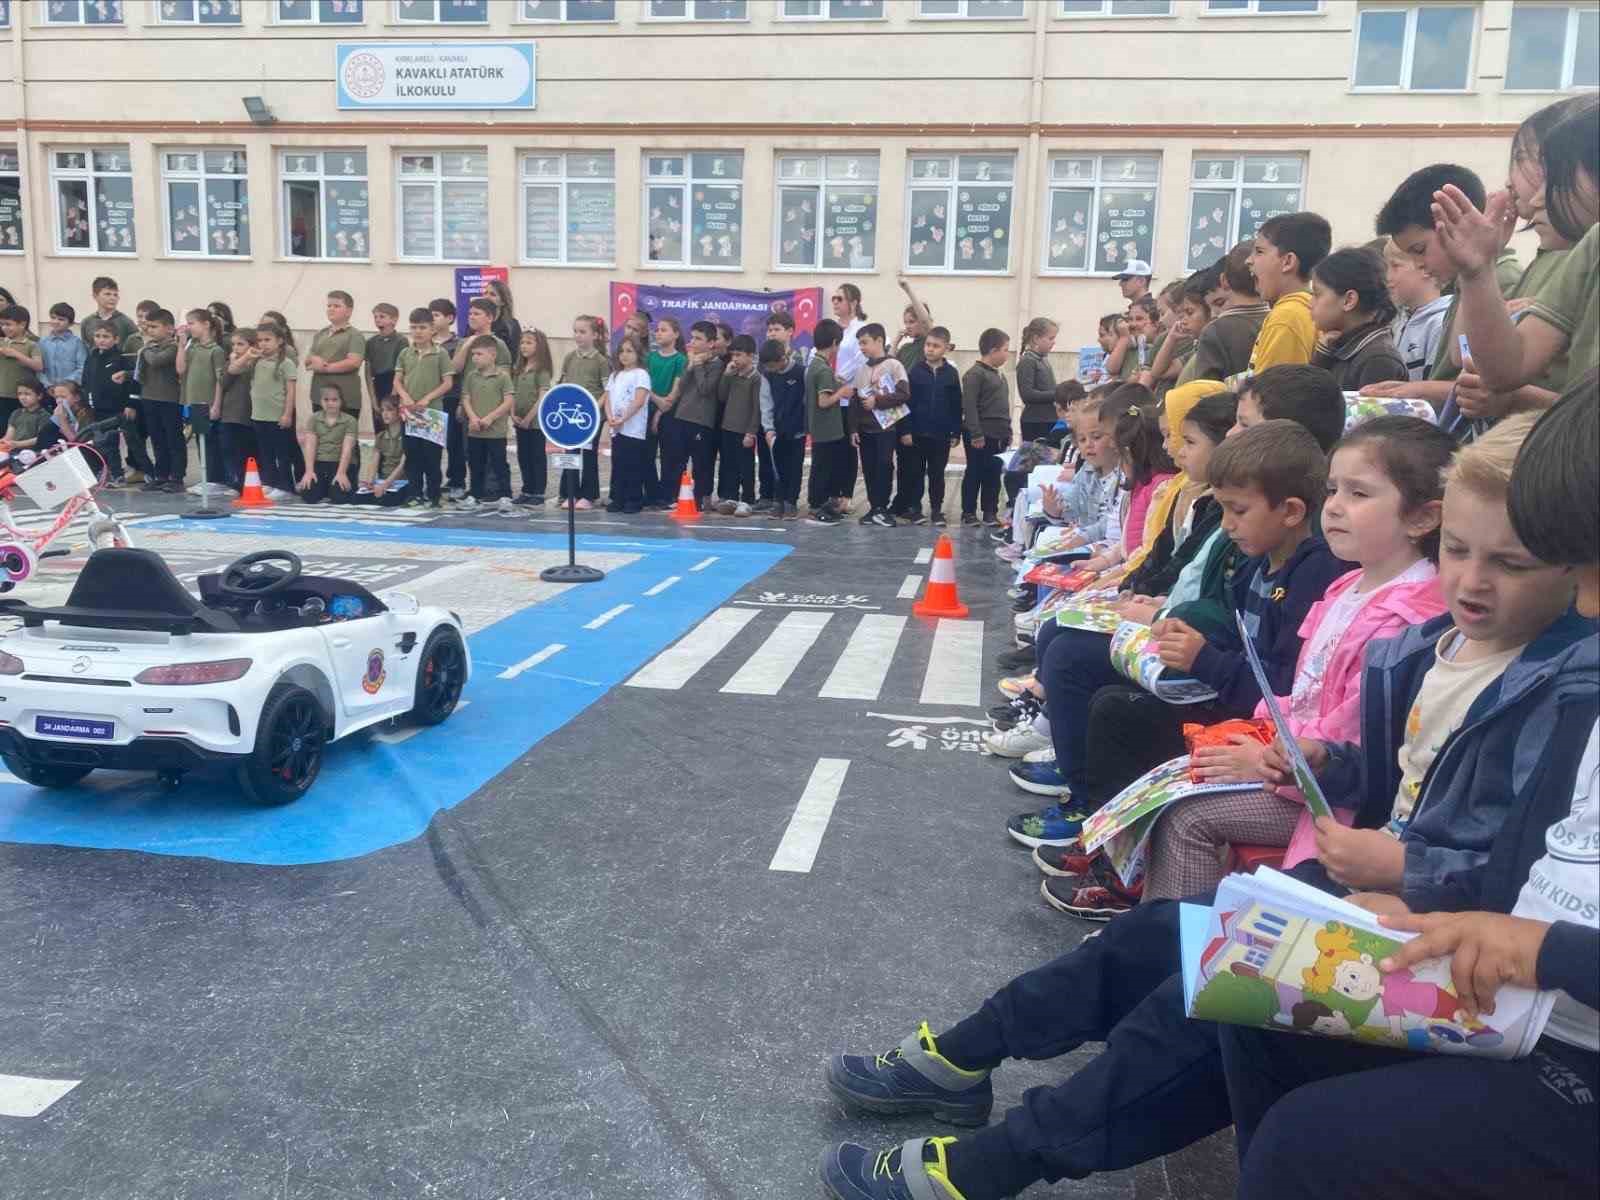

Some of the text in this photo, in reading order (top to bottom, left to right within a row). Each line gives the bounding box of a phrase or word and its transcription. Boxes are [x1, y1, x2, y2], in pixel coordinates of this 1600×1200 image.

[395, 64, 504, 80] KAVAKLI ATATÜRK
[396, 84, 456, 97] İLKOKULU
[661, 298, 768, 311] TRAFİK JANDARMASI
[53, 724, 90, 733] JANDARMA
[1547, 884, 1599, 920] KIDS
